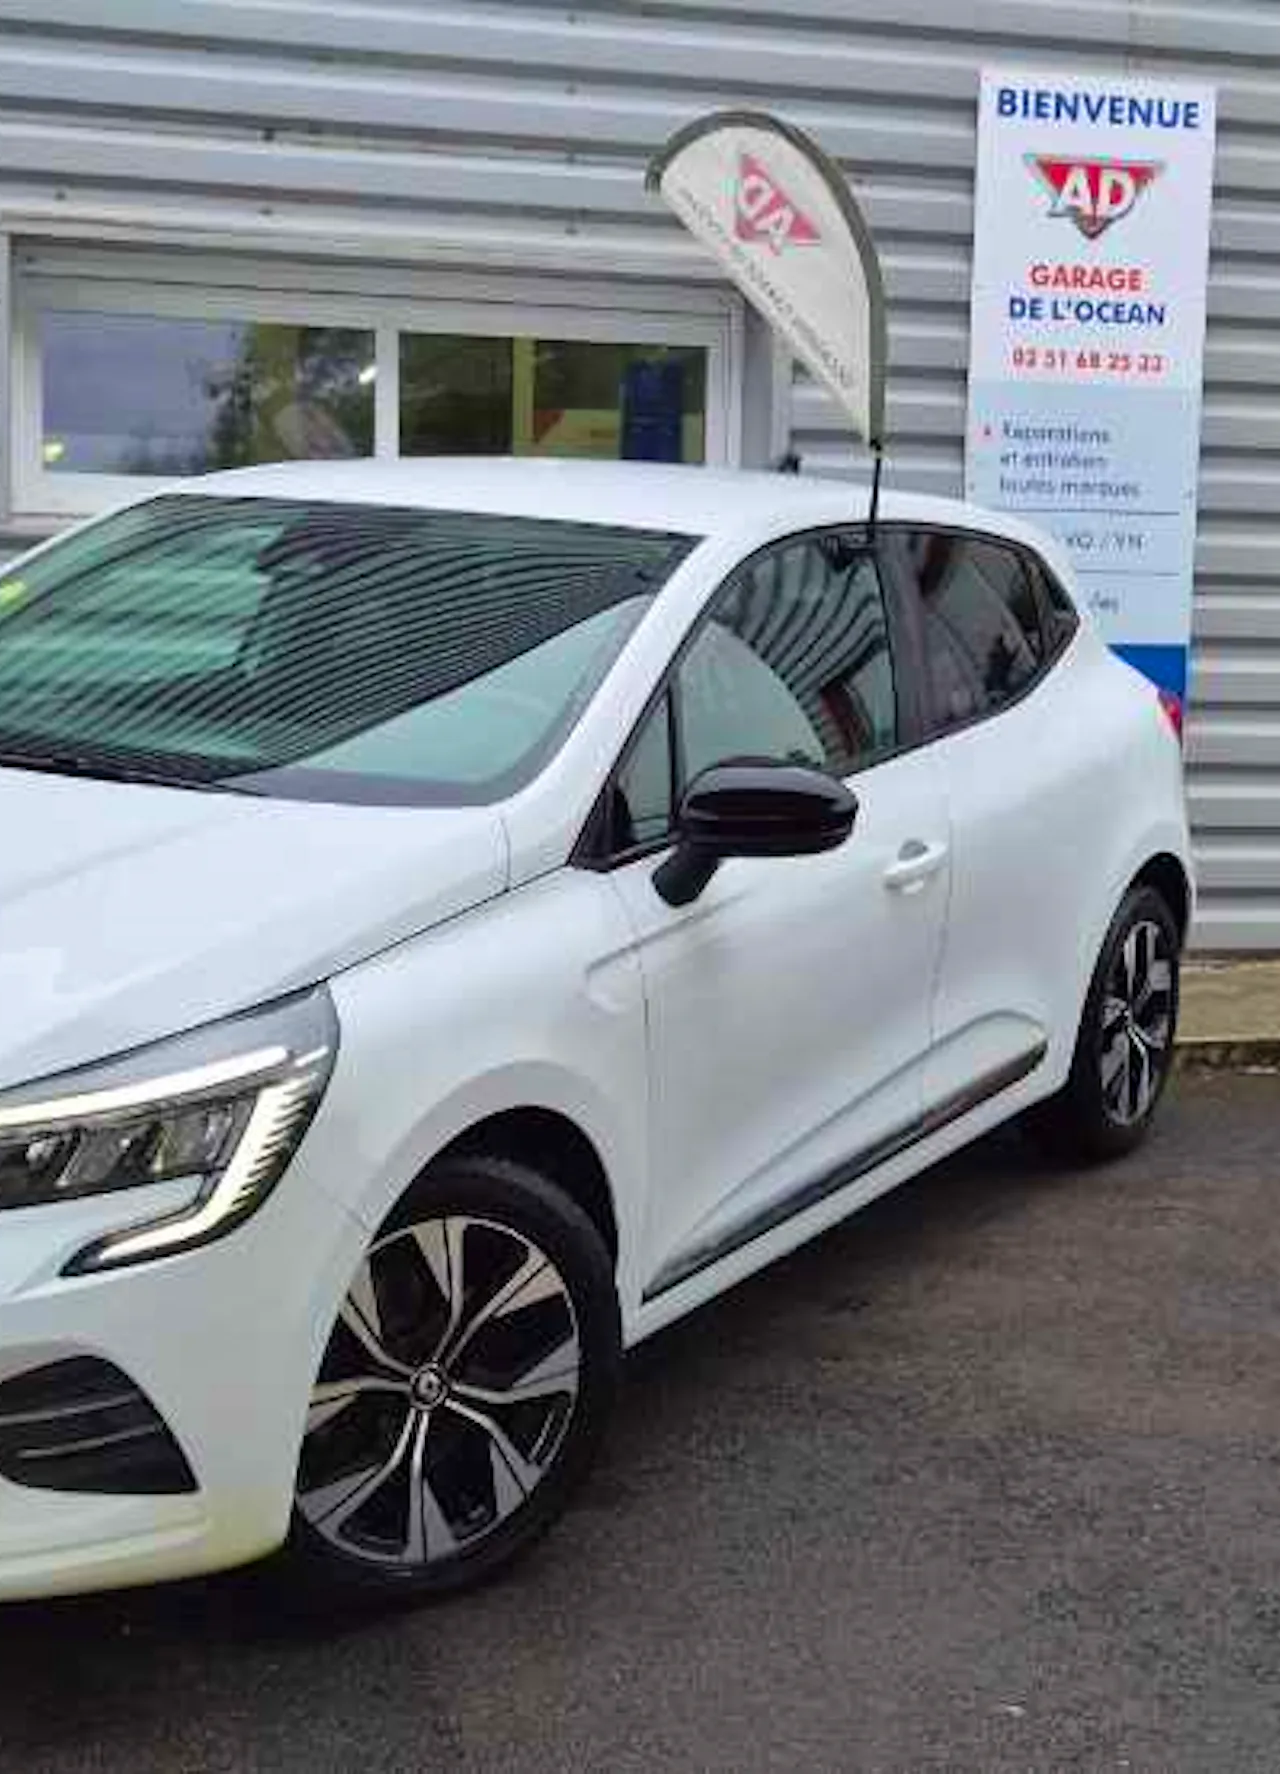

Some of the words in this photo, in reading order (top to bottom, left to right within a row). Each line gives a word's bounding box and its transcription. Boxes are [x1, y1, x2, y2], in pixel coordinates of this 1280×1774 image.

[996, 88, 1200, 128] BIENVENUE
[1057, 165, 1136, 215] AD
[1030, 264, 1142, 291] GARAGE
[1010, 298, 1042, 321] DE
[1051, 300, 1166, 326] L'OCEAN
